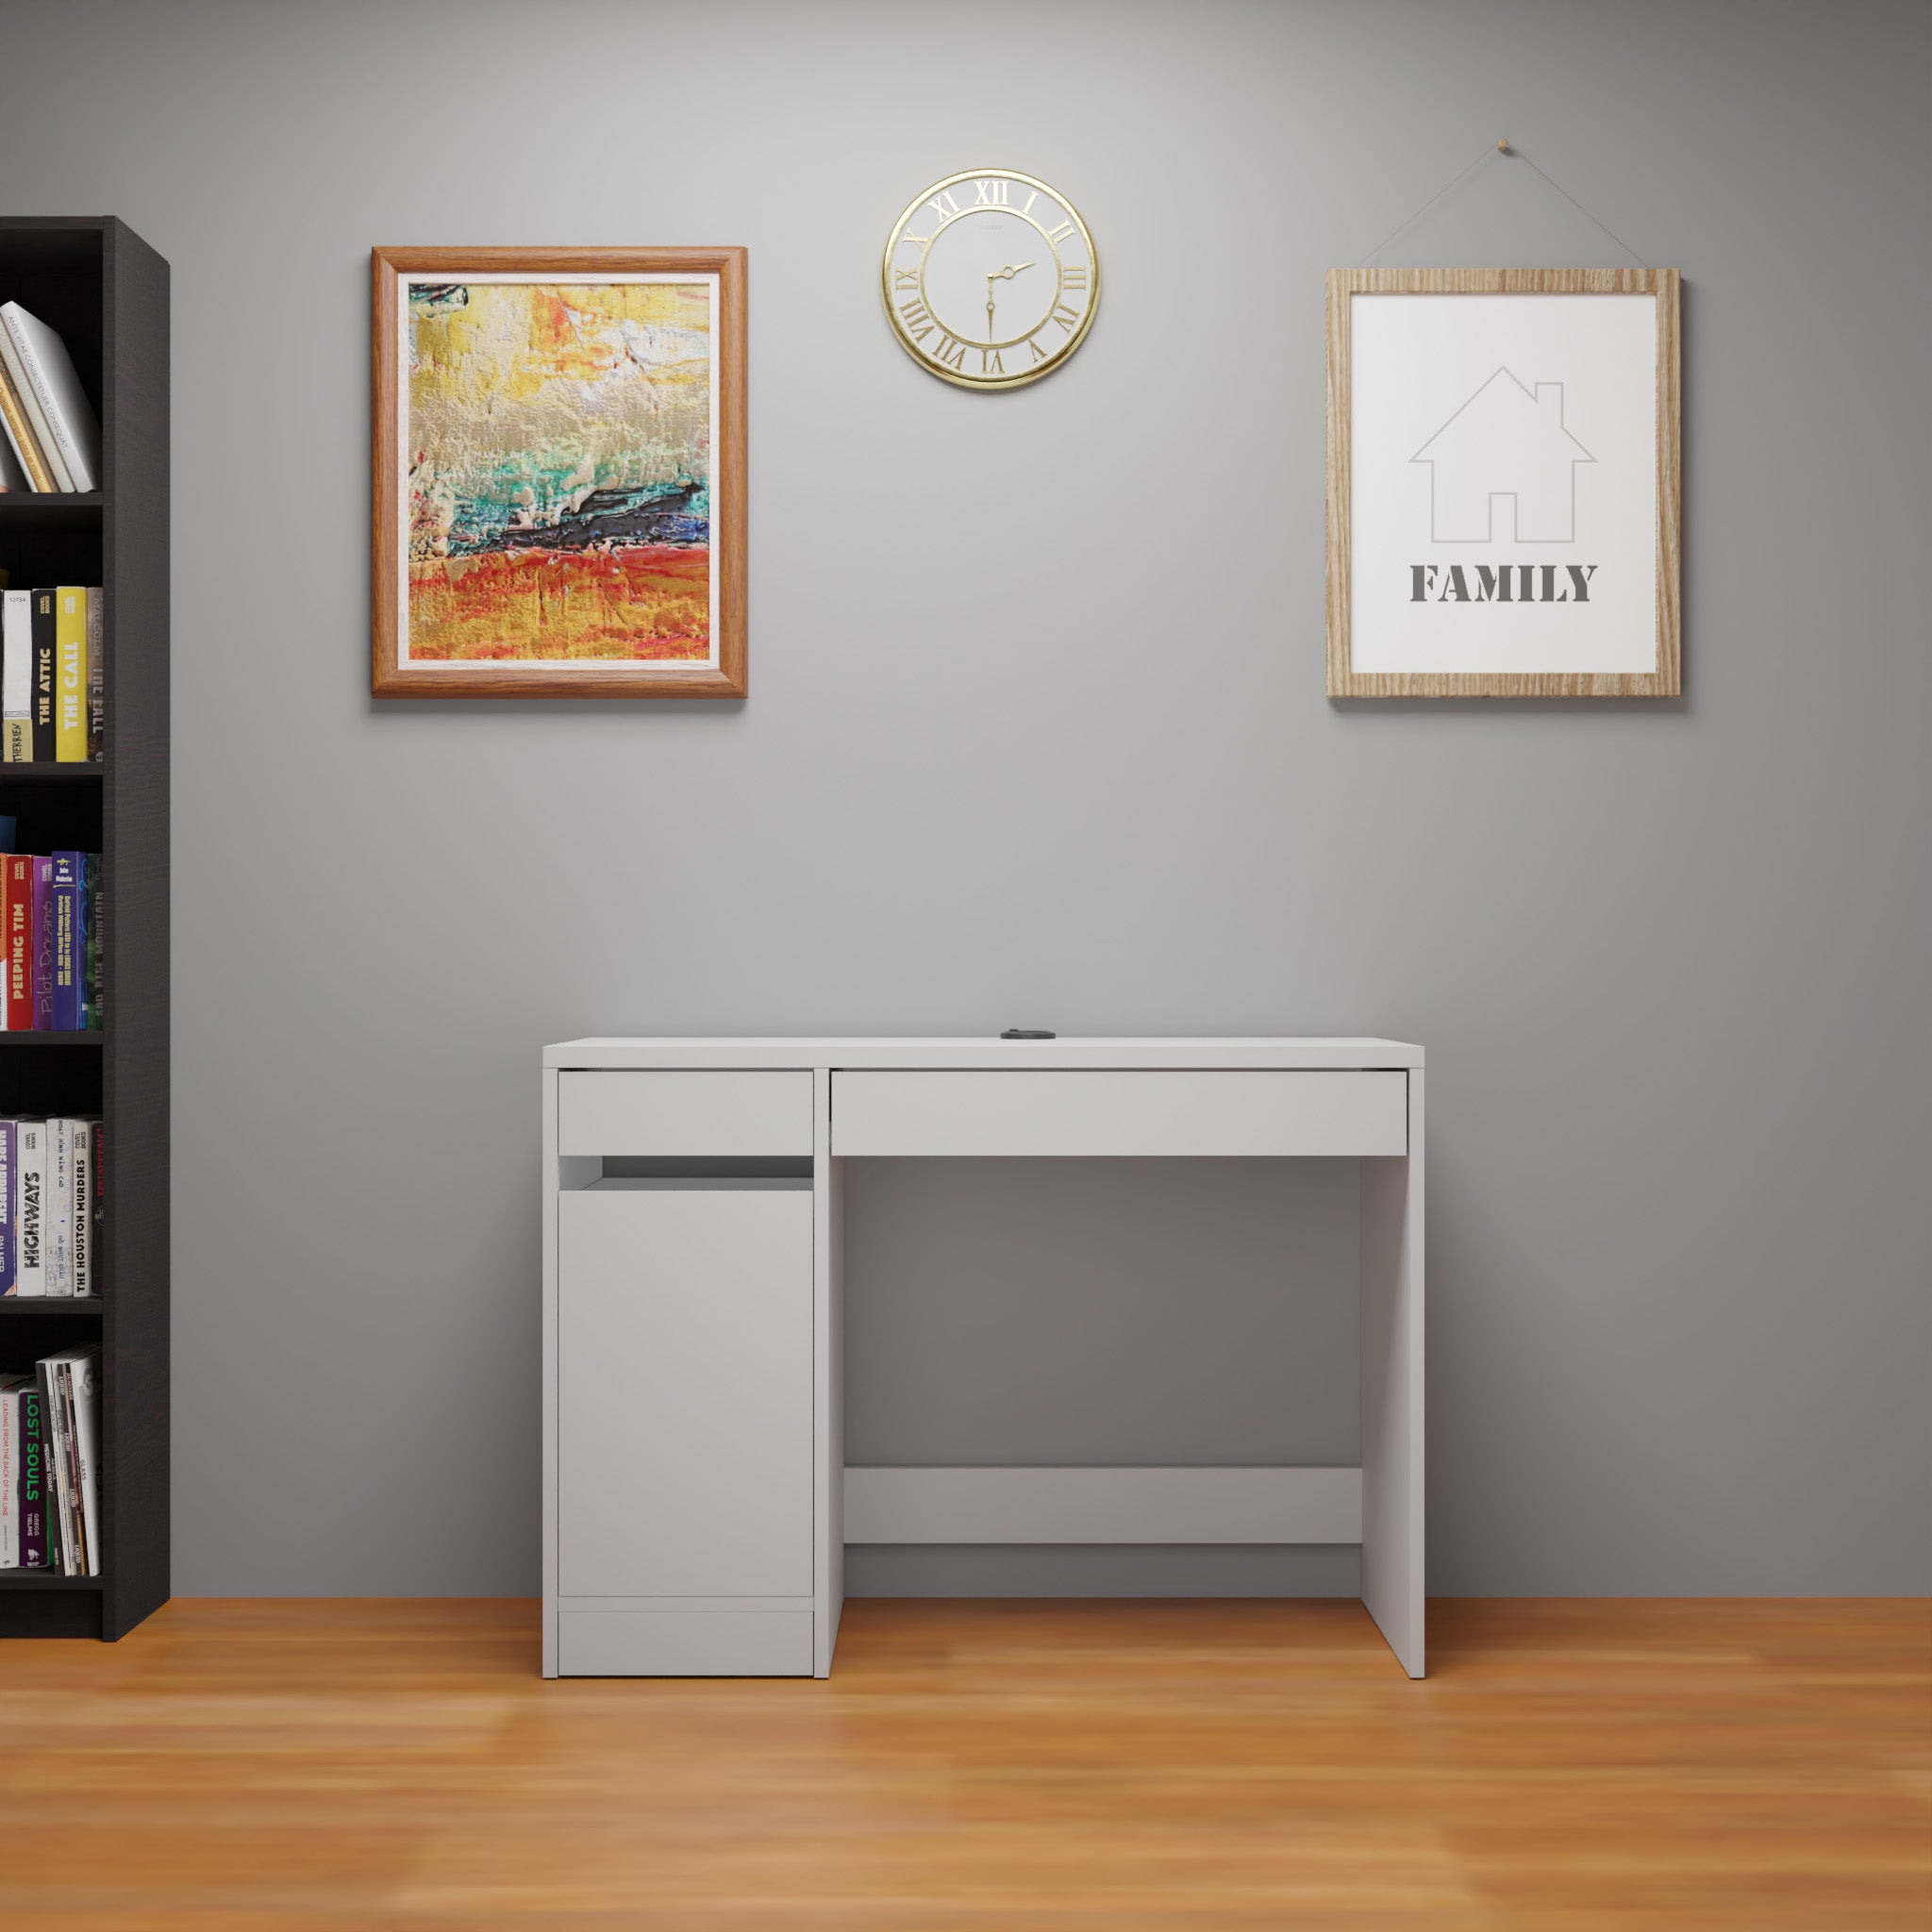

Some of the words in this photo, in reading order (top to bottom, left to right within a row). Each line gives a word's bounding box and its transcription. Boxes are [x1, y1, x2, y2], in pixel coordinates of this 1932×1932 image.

[927, 191, 962, 224] XI
[974, 180, 1009, 206] XII
[901, 228, 930, 251] X
[1048, 219, 1075, 244] II
[895, 267, 919, 291] IX
[1062, 265, 1087, 291] III
[899, 297, 935, 342] VIII
[1053, 303, 1080, 334] IV
[932, 335, 967, 371] VII
[981, 349, 1006, 375] VI
[1028, 339, 1047, 363] V
[47, 407, 69, 449] CONSEQUAT
[1409, 565, 1598, 602] FAMILY
[40, 648, 51, 692] ATTIC
[64, 641, 78, 689] CALL
[40, 698, 51, 725] THE
[64, 695, 78, 730] THE
[13, 904, 24, 931] TIM
[40, 901, 52, 968] Dreams
[95, 891, 104, 955] MOUNTAIN
[13, 936, 24, 1000] PEEPING
[95, 958, 104, 987] RISE
[37, 972, 52, 1015] Pilot
[76, 1159, 85, 1211] MURDERS
[24, 1172, 40, 1268] HIGHWAYS
[76, 1215, 85, 1268] HOUSTON
[76, 1273, 85, 1292] THE
[26, 1393, 39, 1438] LOST
[2, 1479, 8, 1488] OF
[26, 1442, 39, 1500] SOULS
